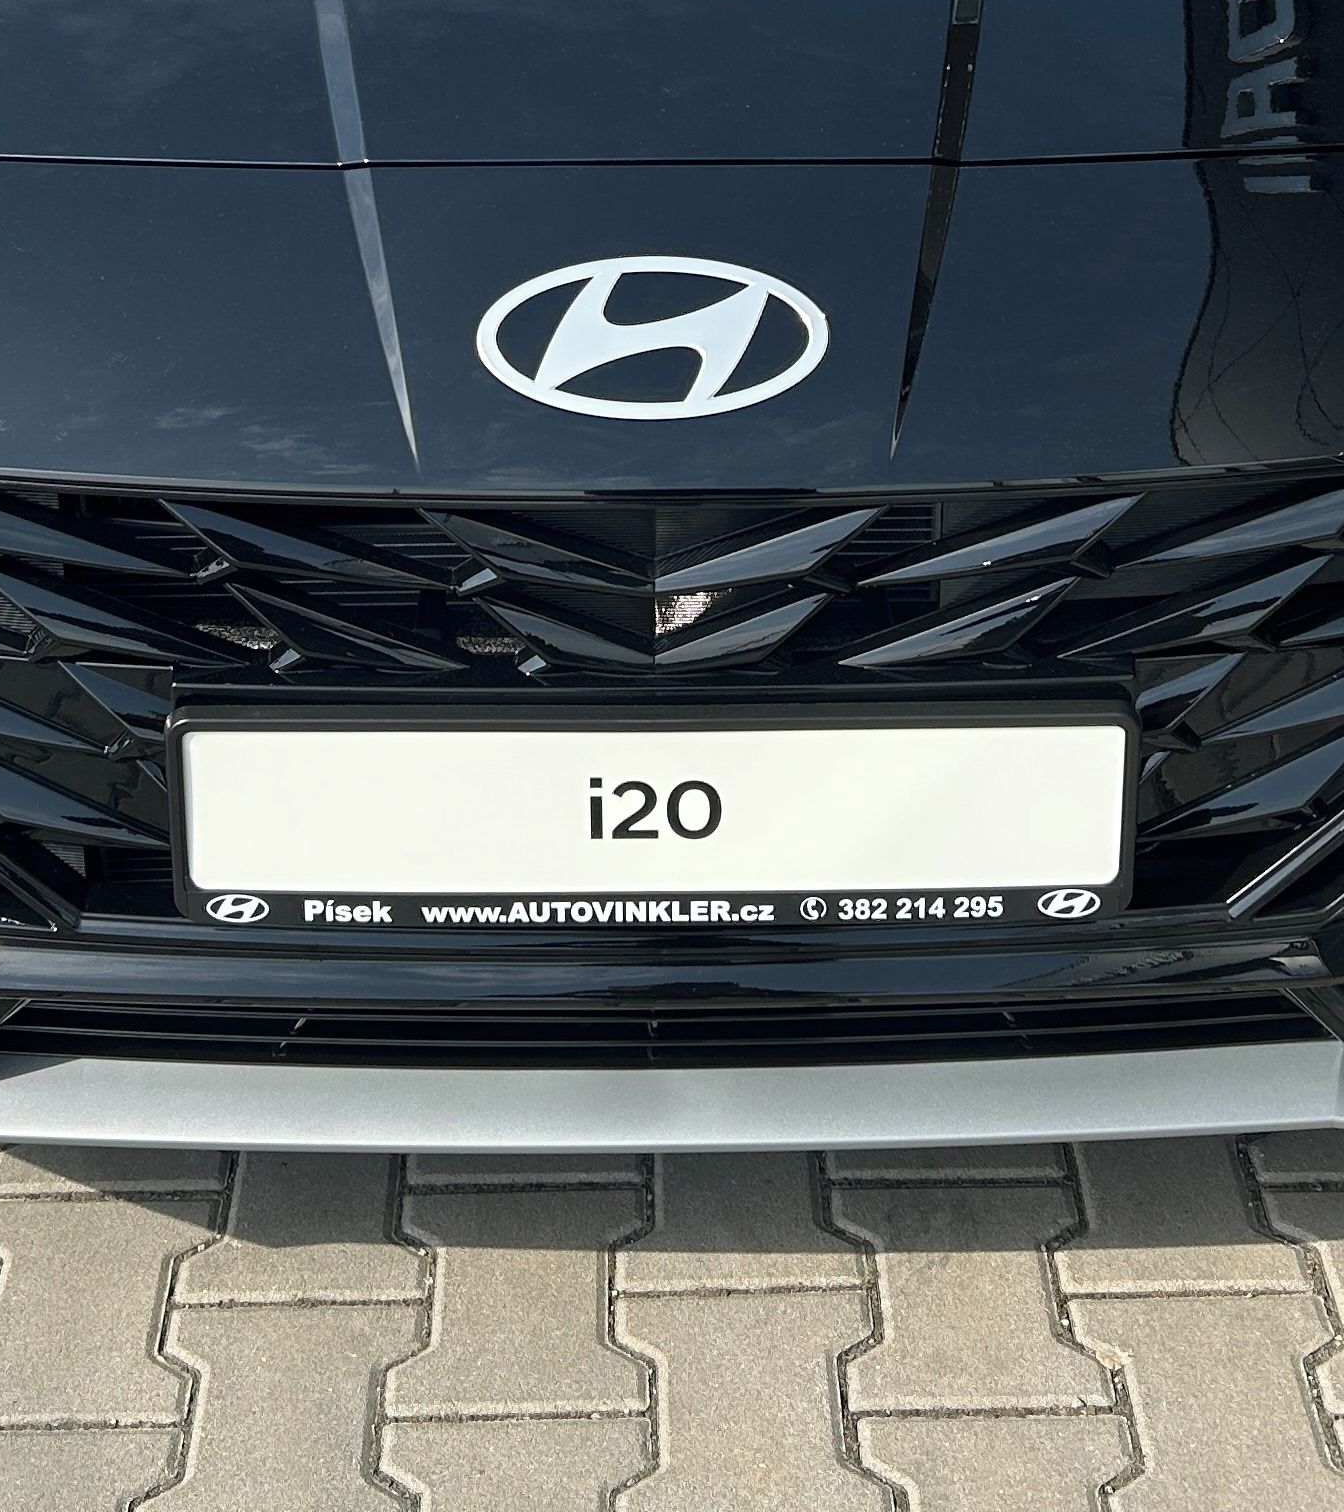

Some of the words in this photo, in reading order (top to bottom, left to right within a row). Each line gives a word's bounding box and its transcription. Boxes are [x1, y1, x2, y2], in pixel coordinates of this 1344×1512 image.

[589, 776, 723, 840] i20
[304, 899, 393, 924] Písek
[421, 900, 775, 924] www.AUTOVINKLER.cz
[837, 898, 888, 921] 382
[895, 896, 946, 920] 214
[953, 895, 1004, 919] 295
